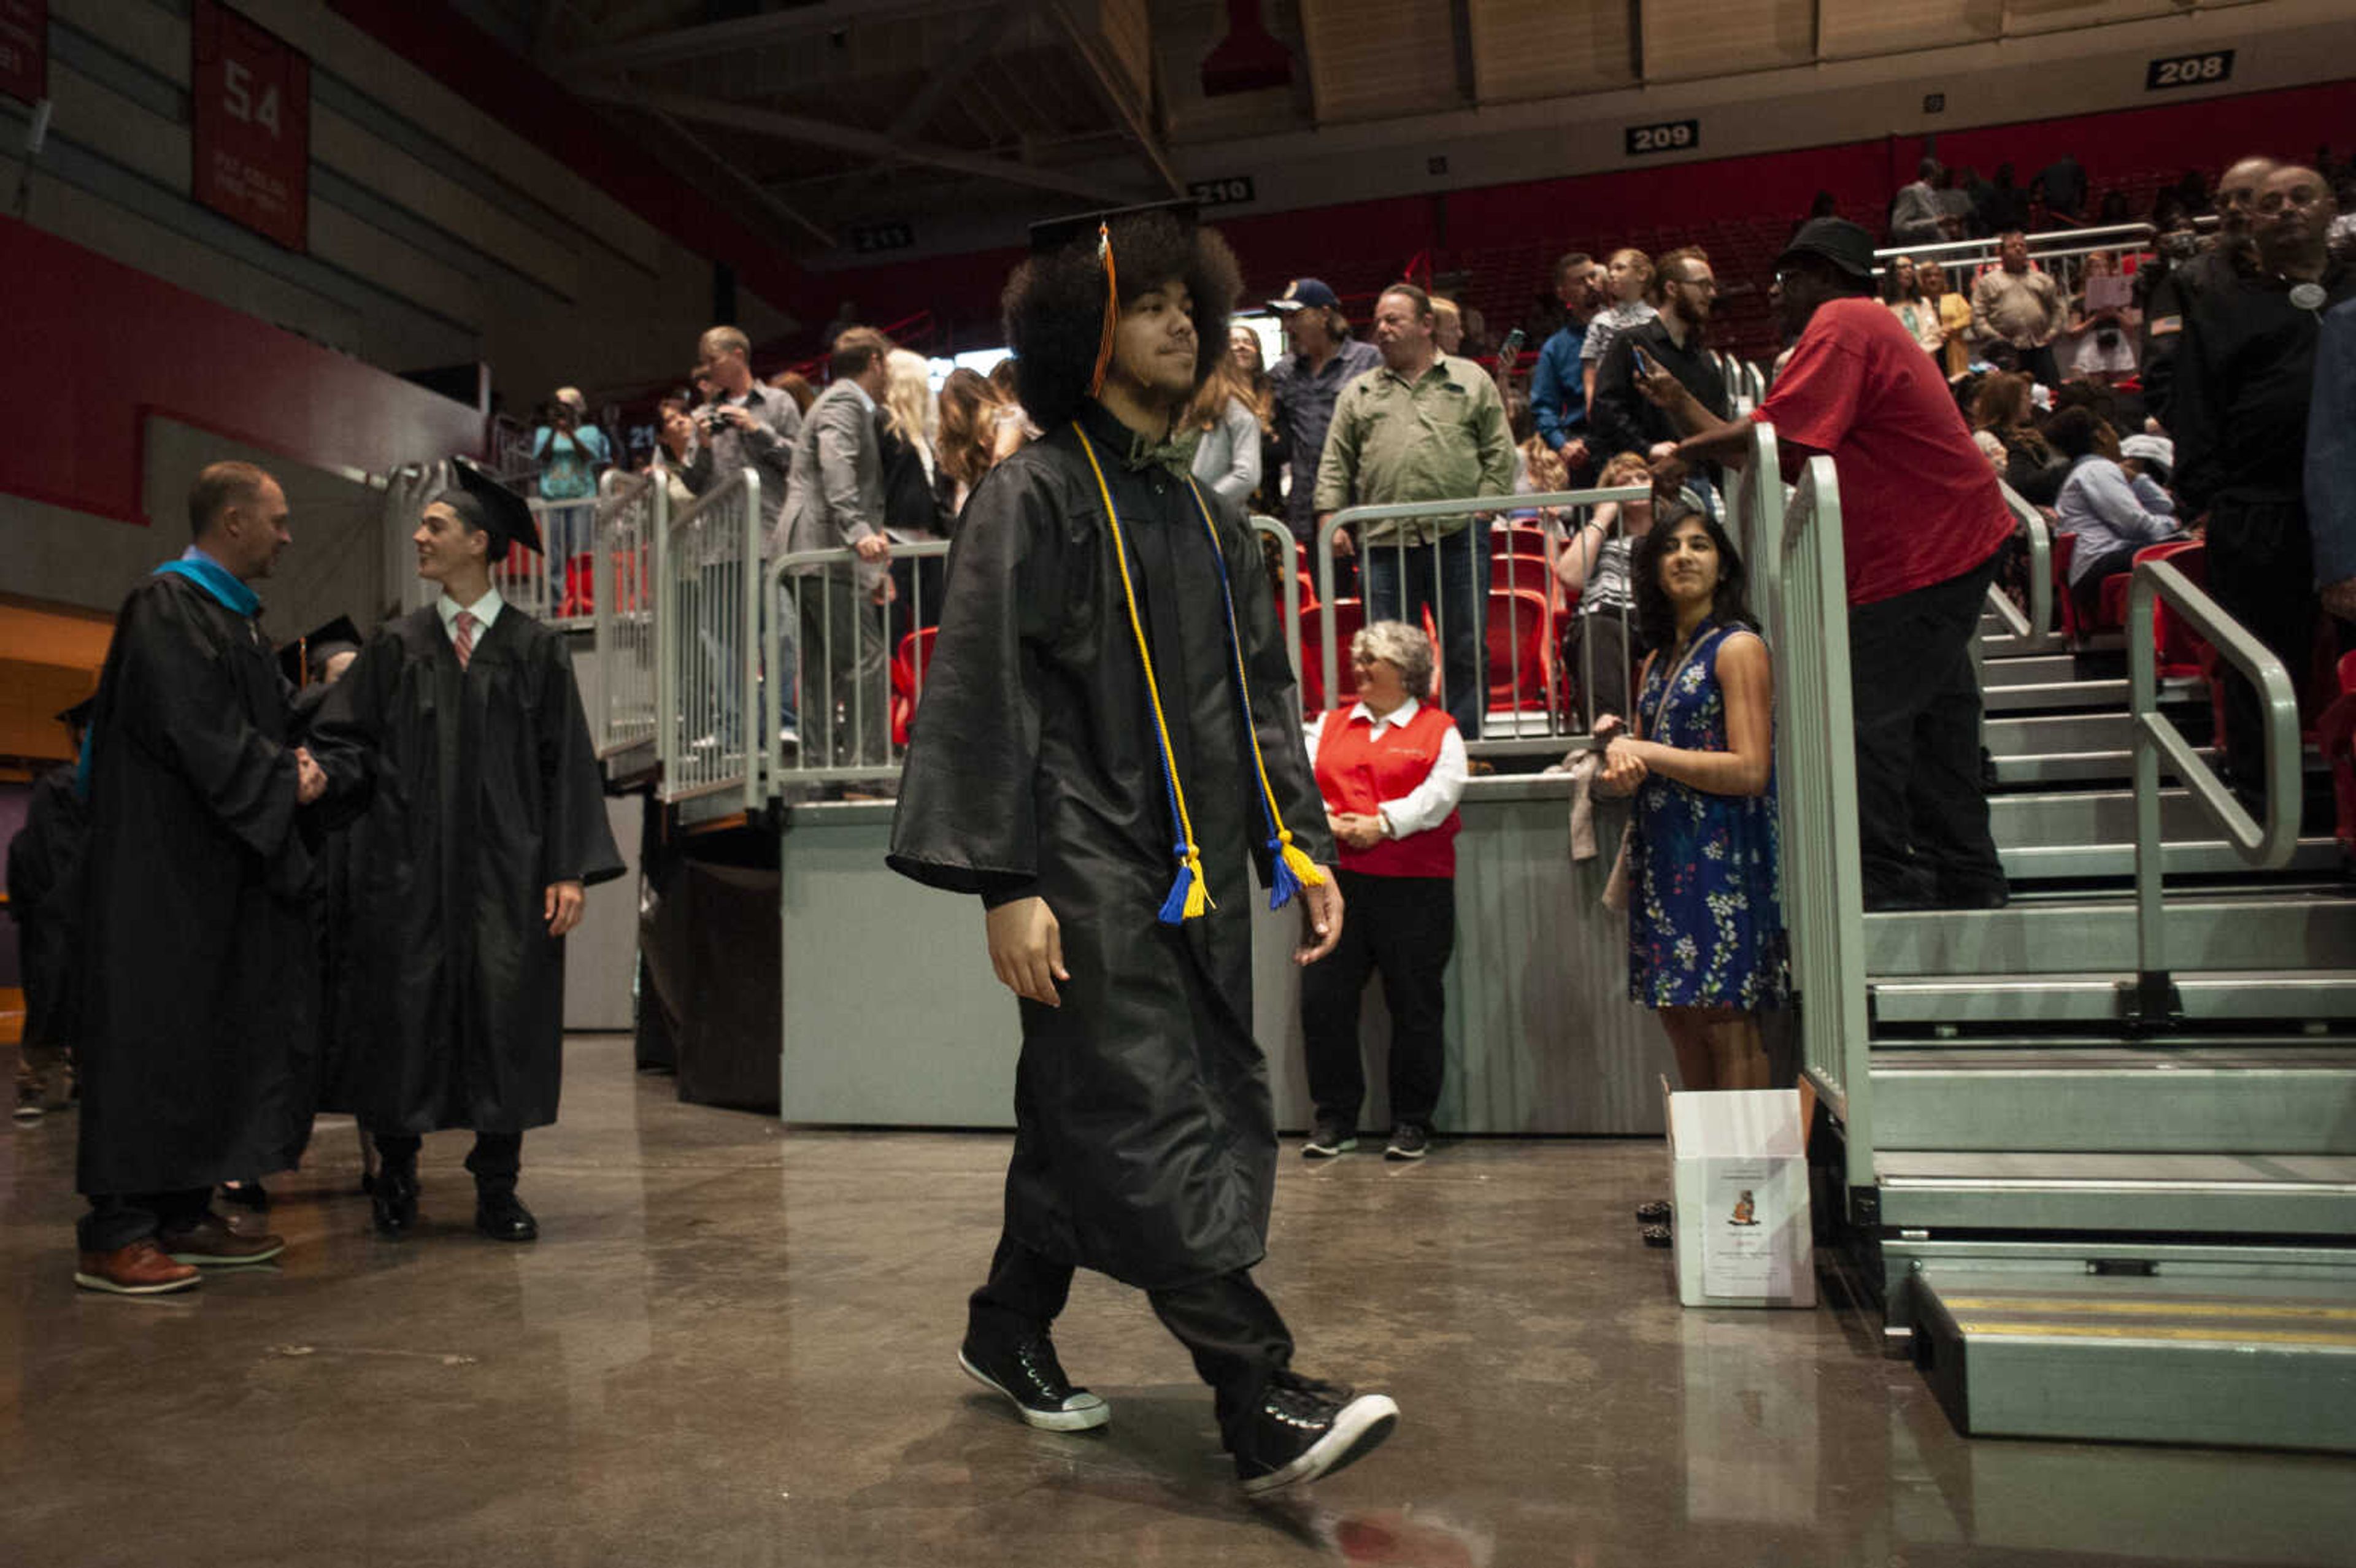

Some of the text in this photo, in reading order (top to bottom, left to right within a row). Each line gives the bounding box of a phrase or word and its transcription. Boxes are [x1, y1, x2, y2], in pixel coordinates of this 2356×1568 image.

[2156, 56, 2223, 84] 208
[223, 59, 281, 139] 54
[1634, 124, 1690, 152] 209
[1197, 180, 1248, 204] 210
